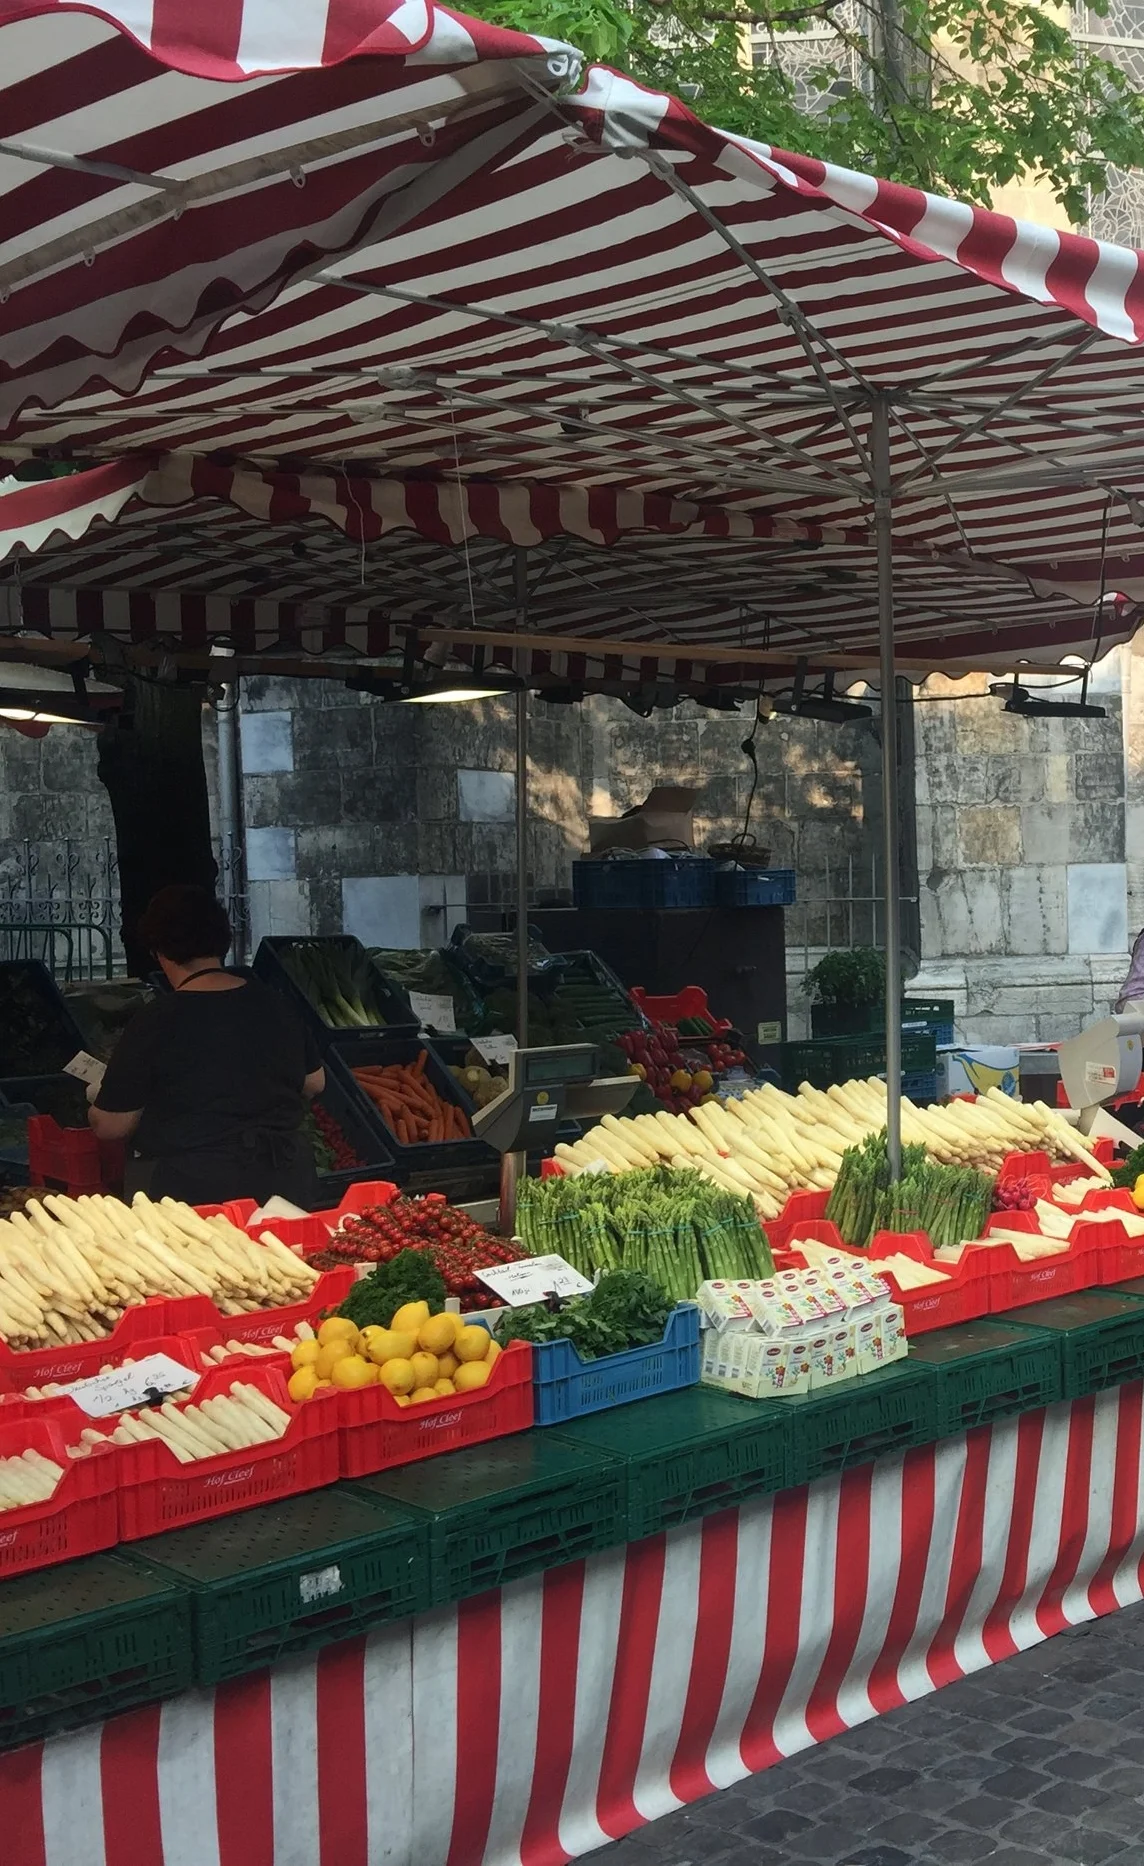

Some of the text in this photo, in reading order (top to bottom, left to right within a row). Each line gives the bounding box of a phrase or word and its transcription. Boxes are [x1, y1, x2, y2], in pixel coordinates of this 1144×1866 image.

[241, 1322, 286, 1342] Hof Cleef
[33, 1359, 85, 1379] Hof Cleef
[419, 1407, 465, 1430] Hof Cleef
[203, 1463, 257, 1488] Hof Cleef
